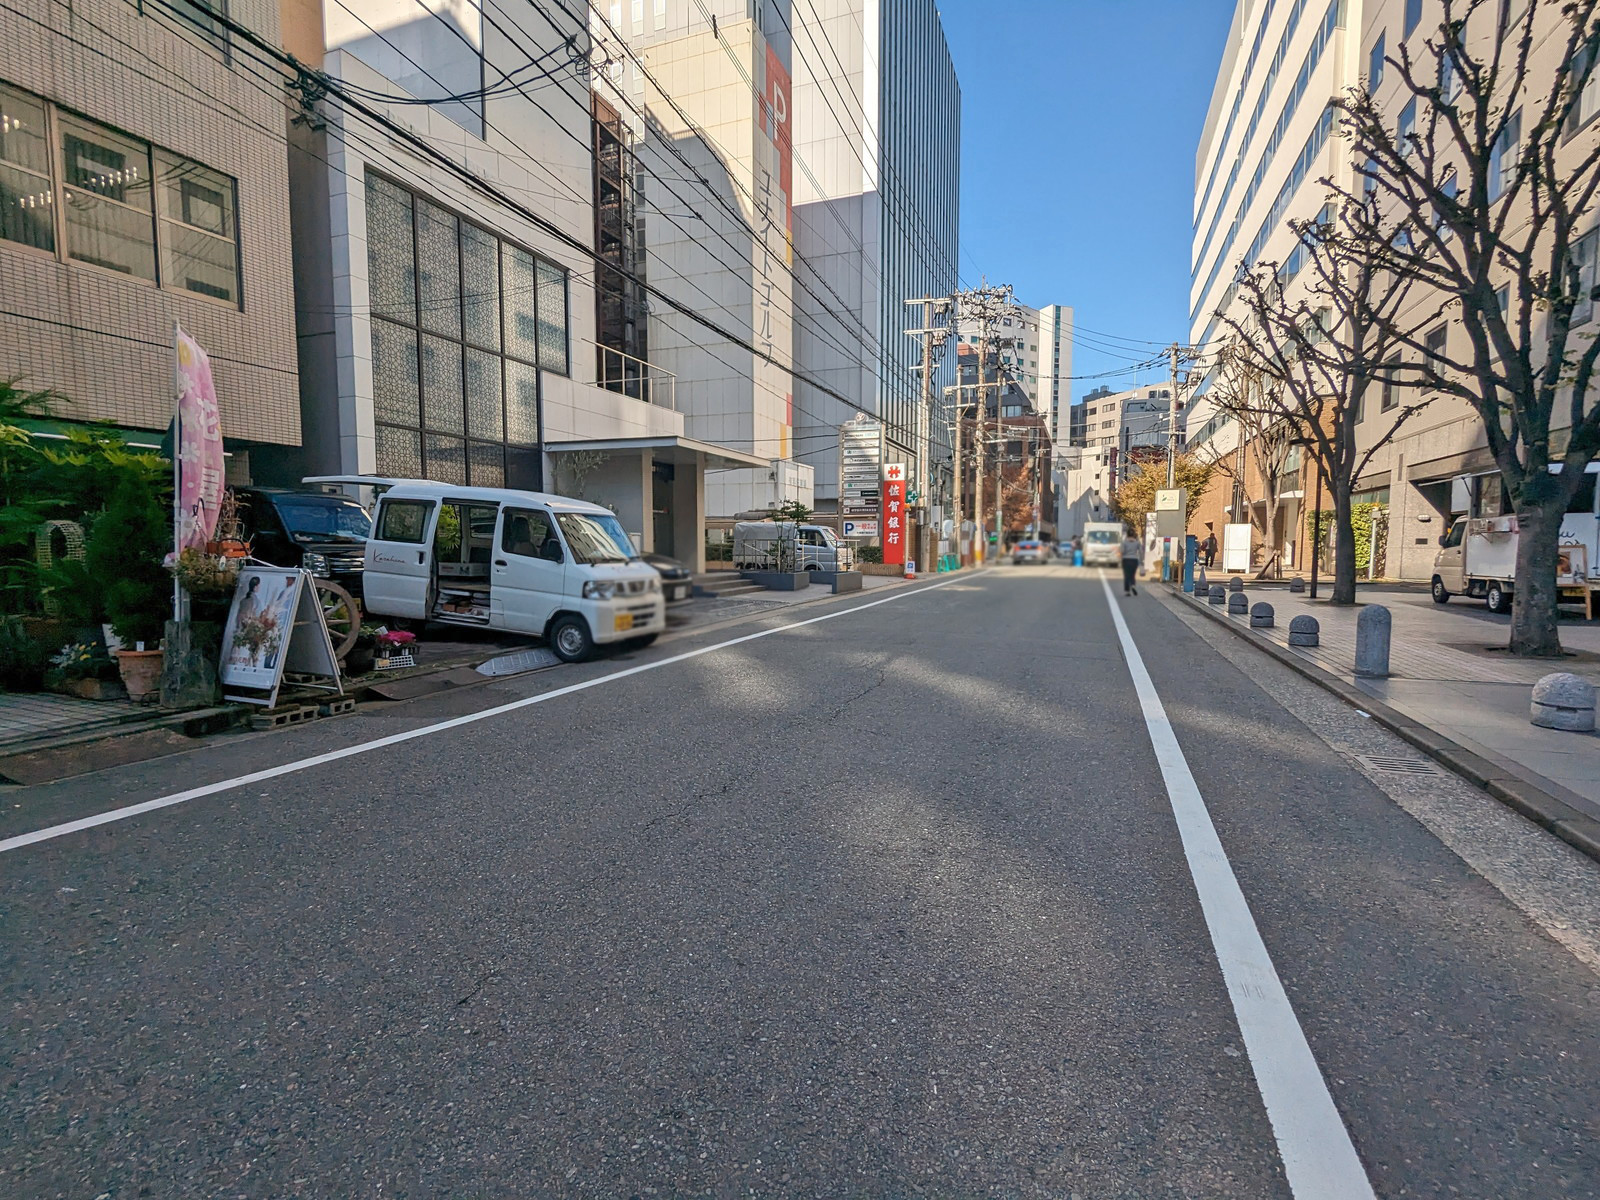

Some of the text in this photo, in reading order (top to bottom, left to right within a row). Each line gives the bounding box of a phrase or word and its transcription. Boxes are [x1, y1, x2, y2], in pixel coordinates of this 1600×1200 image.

[773, 80, 787, 141] P
[845, 522, 854, 534] P
[888, 484, 900, 545] 佐賀銀行
